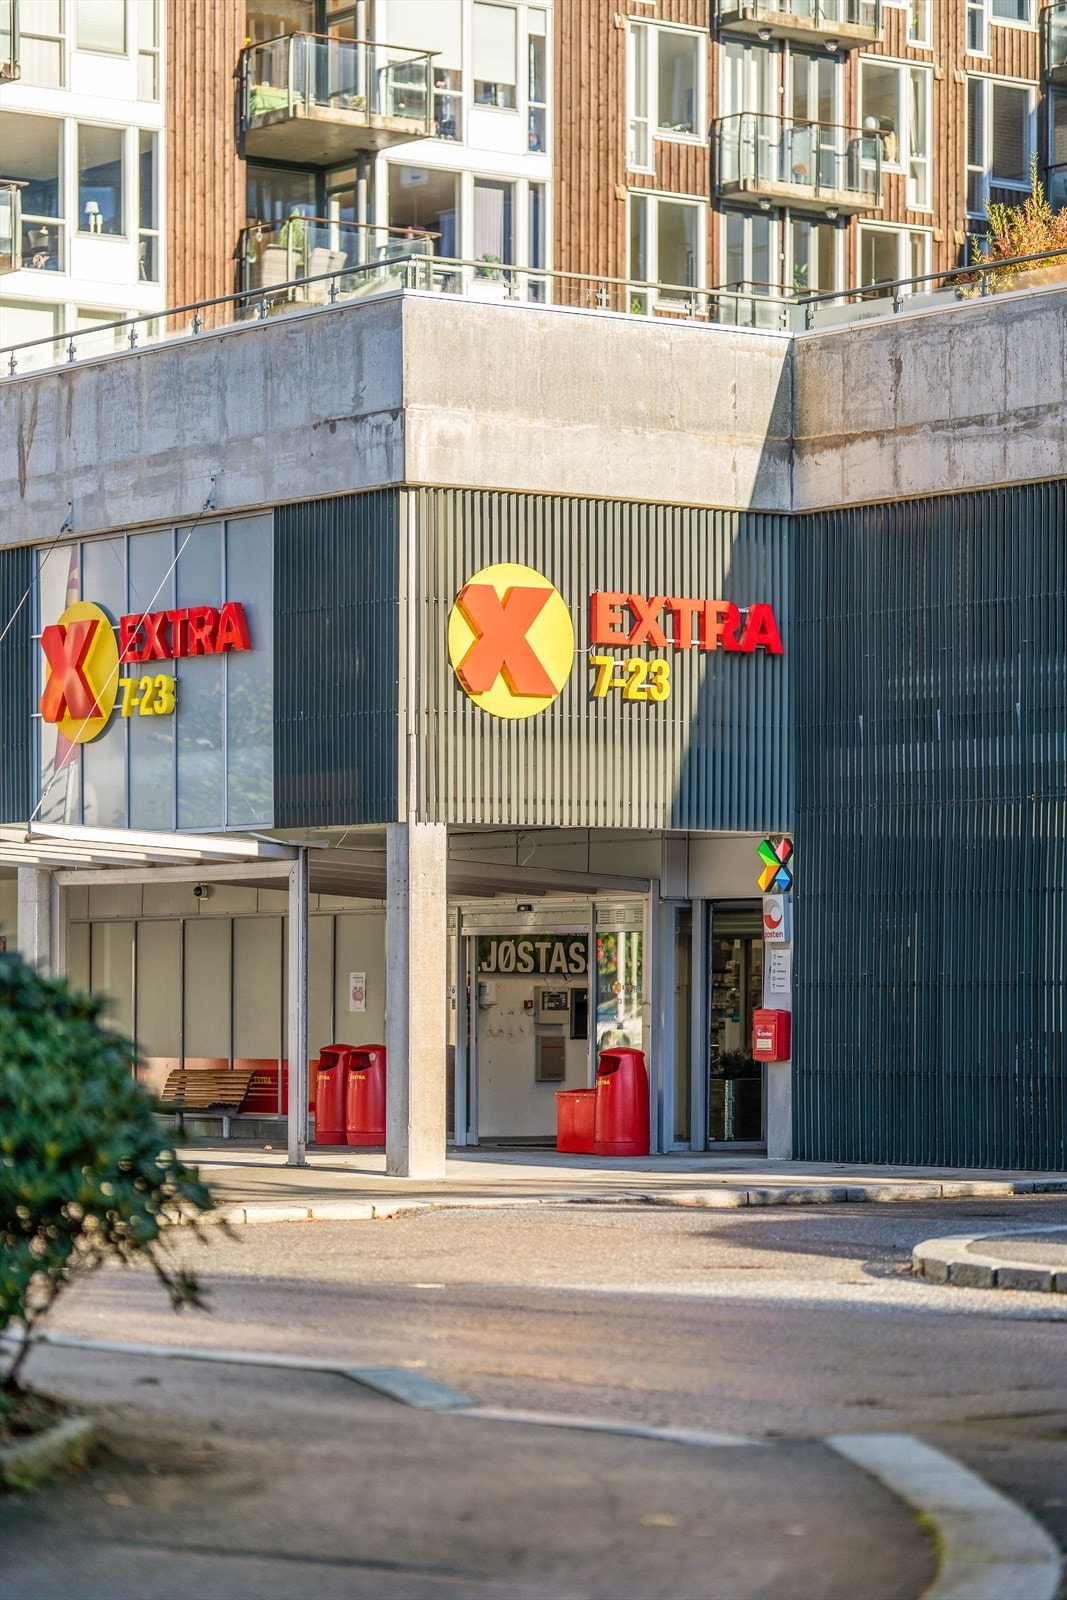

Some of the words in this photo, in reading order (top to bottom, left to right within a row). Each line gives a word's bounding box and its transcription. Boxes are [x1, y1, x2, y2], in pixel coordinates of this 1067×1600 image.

[119, 601, 252, 664] EXTRA
[456, 584, 560, 698] X
[590, 591, 784, 656] EXTRA
[119, 673, 178, 718] 7-23
[590, 655, 671, 702] 7-23
[478, 939, 589, 973] JØSTAS
